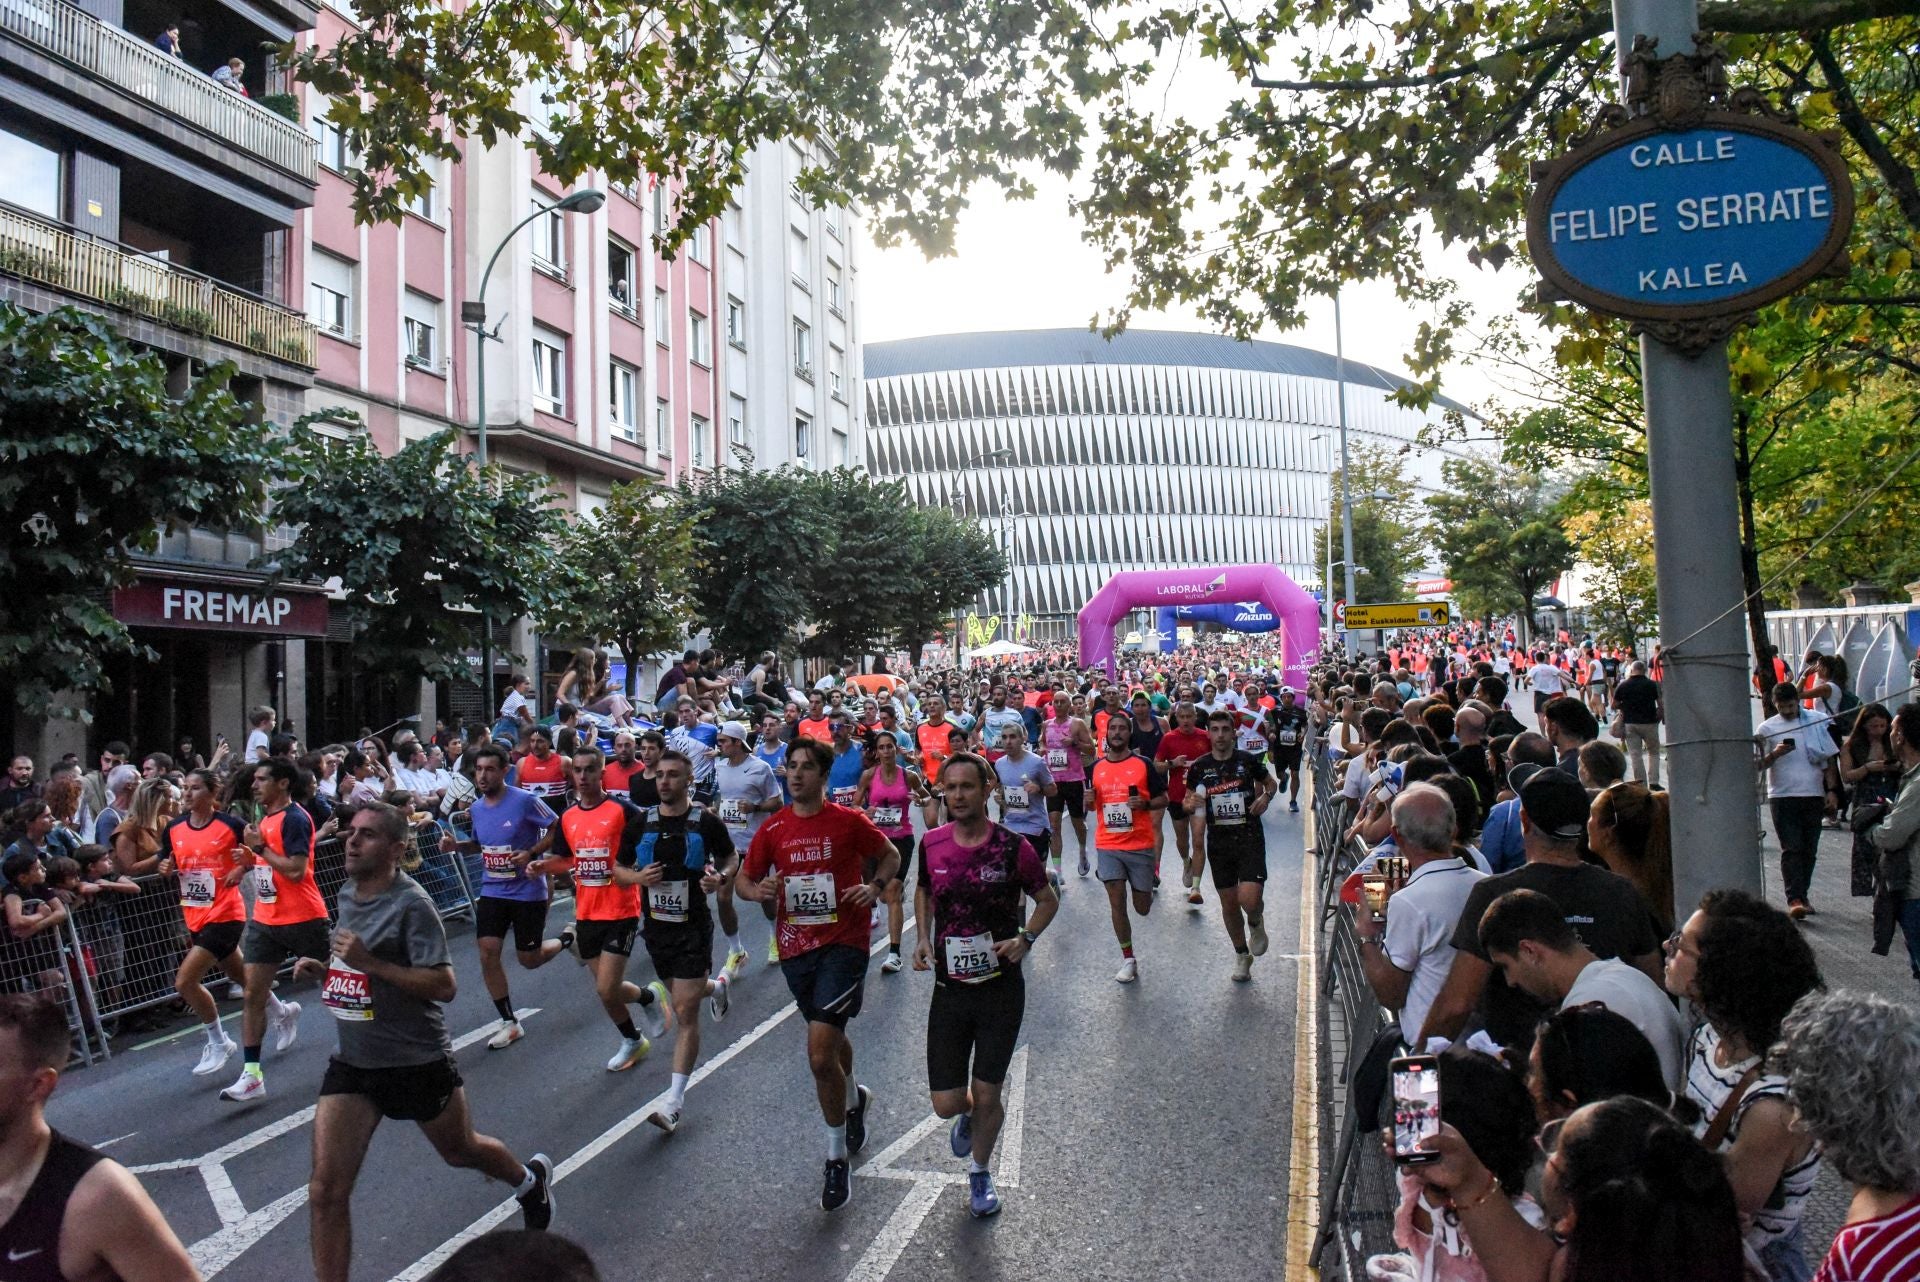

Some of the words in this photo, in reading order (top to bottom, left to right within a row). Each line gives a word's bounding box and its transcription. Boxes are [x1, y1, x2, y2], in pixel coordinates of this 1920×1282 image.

[1630, 136, 1735, 168] CALLE
[1550, 203, 1658, 243] FELIPE
[1677, 185, 1829, 231] SERRATE
[1638, 262, 1748, 292] KALEA
[1157, 584, 1204, 595] LABORAL
[163, 587, 291, 626] FREMAP
[1347, 609, 1368, 617] Hotel
[1348, 618, 1367, 626] Abba
[1370, 617, 1416, 625] Euskalduna
[1217, 804, 1240, 813] 2169
[1108, 812, 1127, 821] 1524
[484, 856, 512, 866] 21034
[578, 860, 608, 870] 20388
[188, 883, 207, 893] 726
[654, 894, 682, 906] 1864
[793, 891, 828, 905] 1243
[953, 952, 989, 968] 2752
[326, 975, 366, 996] 20454
